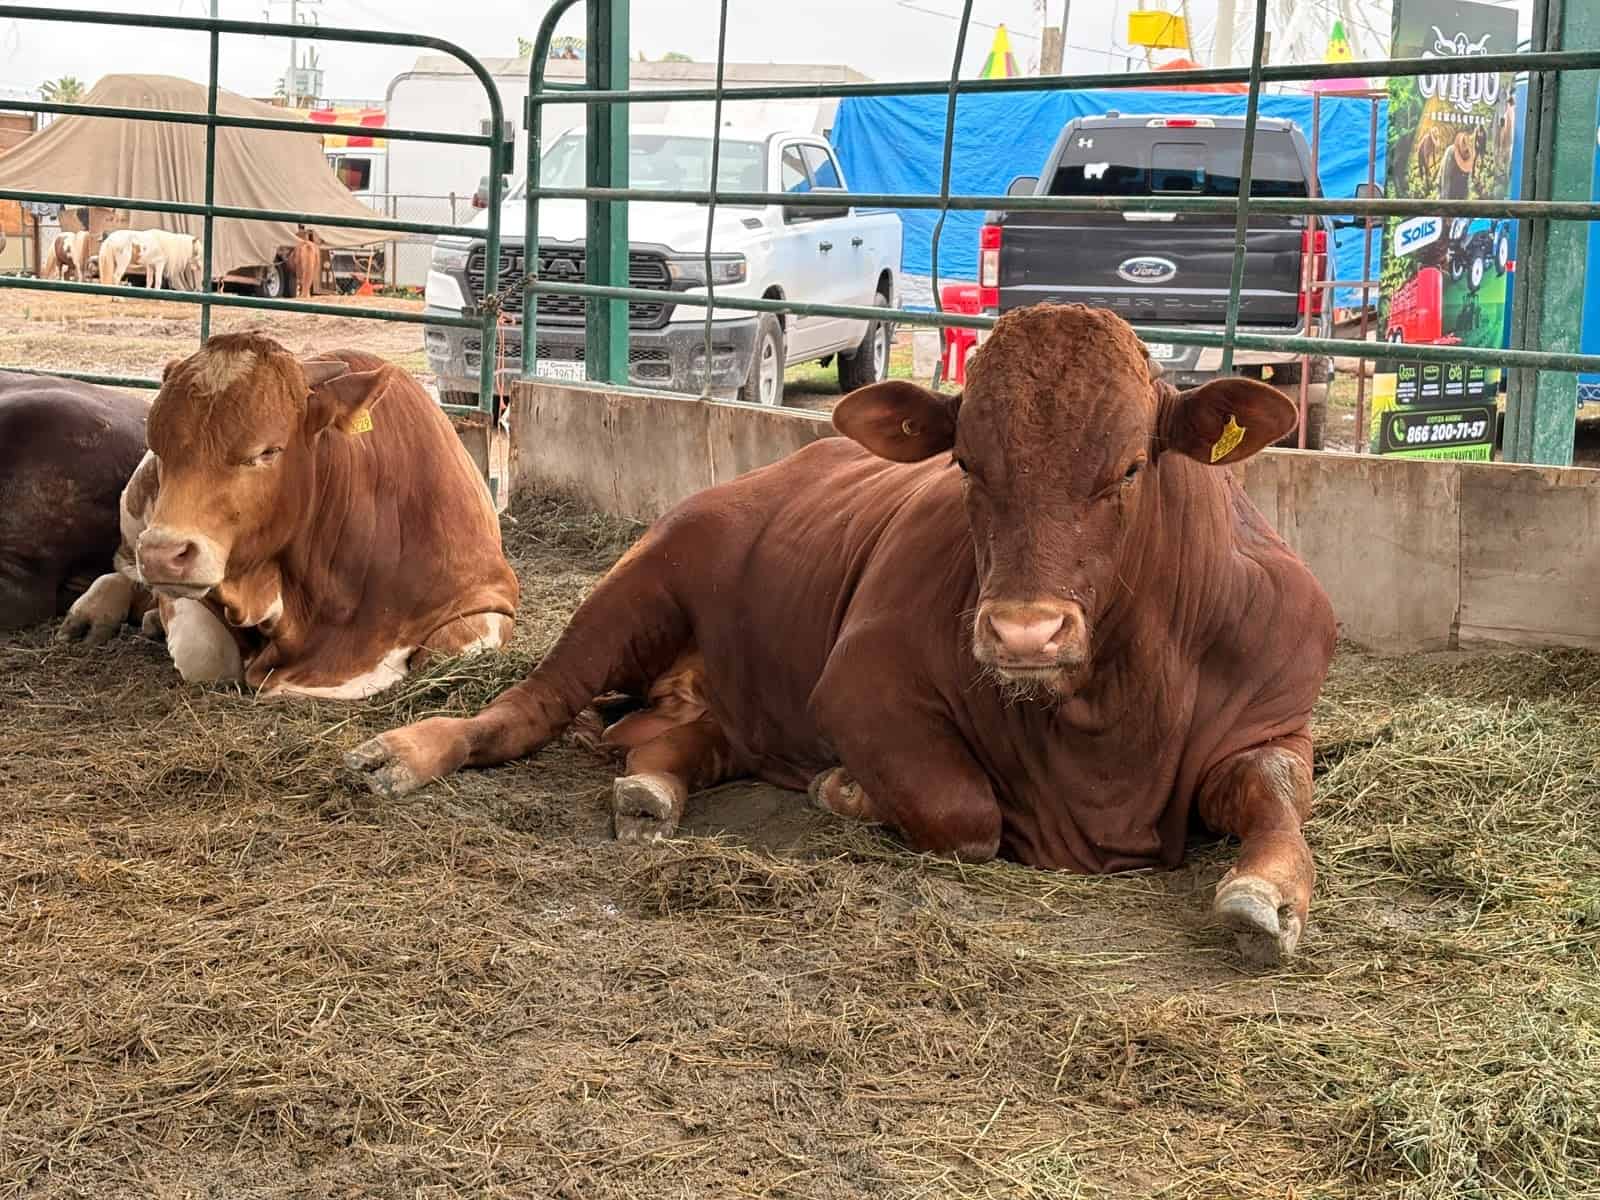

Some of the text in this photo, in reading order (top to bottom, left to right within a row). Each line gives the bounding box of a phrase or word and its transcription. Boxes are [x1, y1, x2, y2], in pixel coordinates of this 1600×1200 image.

[1131, 262, 1163, 277] Ford
[1407, 421, 1486, 443] 866 200-71-57
